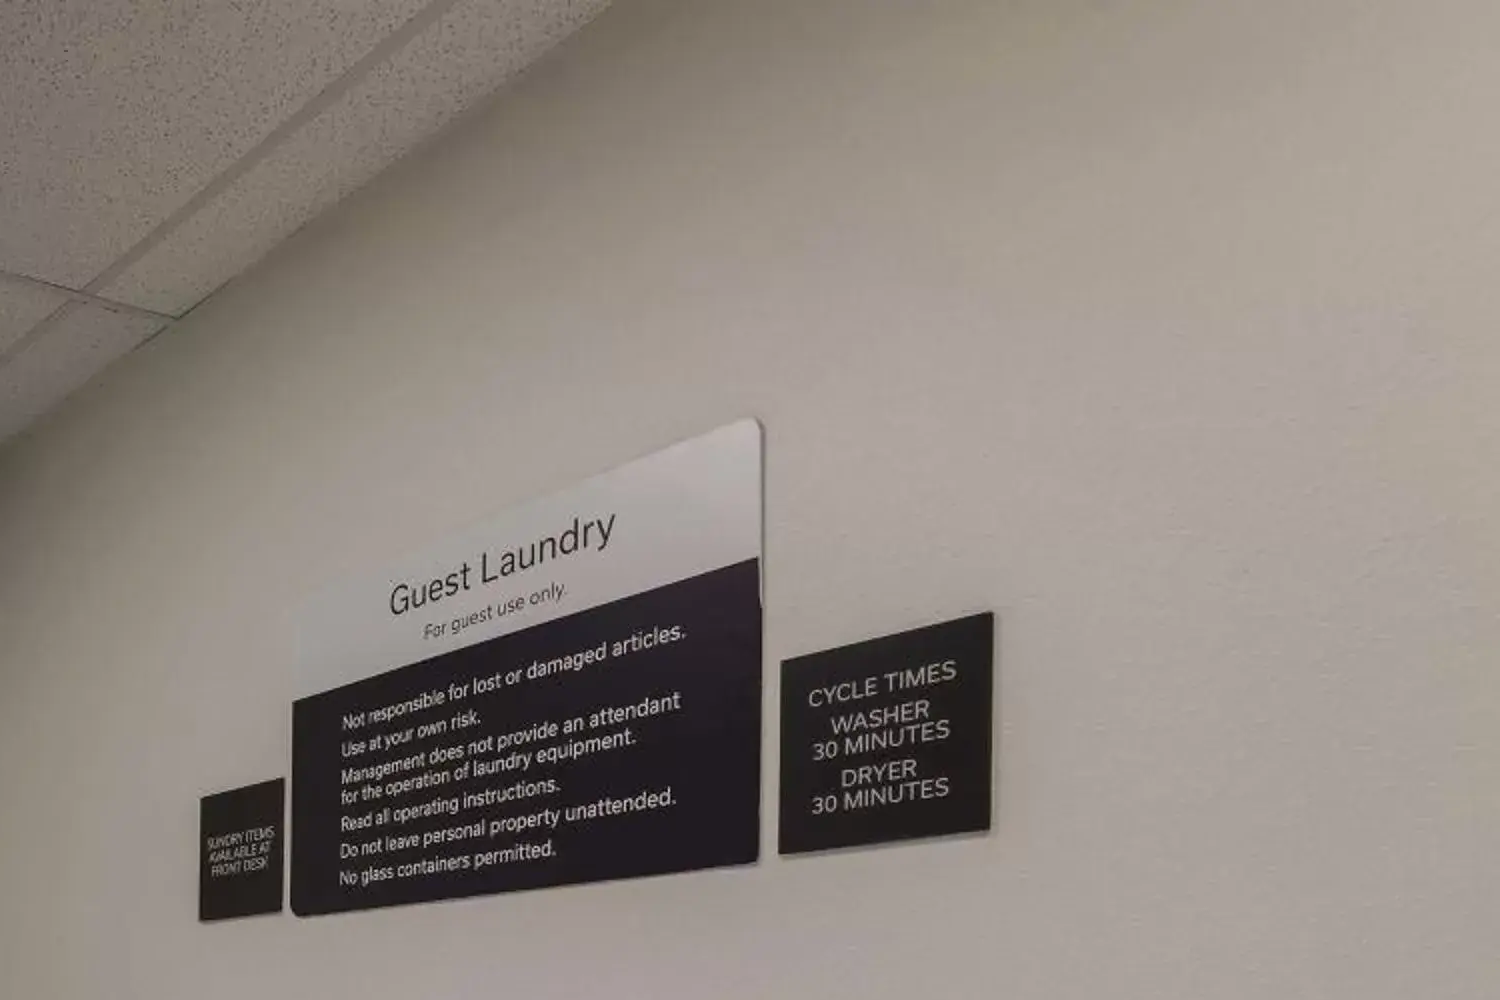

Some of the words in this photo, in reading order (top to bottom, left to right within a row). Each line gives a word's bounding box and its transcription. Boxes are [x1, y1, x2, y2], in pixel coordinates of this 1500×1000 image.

[390, 562, 472, 616] Guest
[481, 513, 616, 585] Laundry
[424, 622, 447, 640] For
[451, 605, 494, 635] guest
[497, 597, 526, 617] use
[529, 581, 568, 606] only.
[342, 711, 365, 731] Not
[368, 689, 445, 724] responsible
[448, 683, 469, 701] for
[472, 673, 501, 695] lost
[505, 669, 522, 685] or
[526, 641, 607, 679] damaged
[611, 625, 687, 657] articles.
[808, 677, 878, 707] CYCLE
[884, 660, 957, 693] TIMES
[341, 741, 366, 757] Use
[369, 735, 381, 751] at
[384, 727, 414, 750] your
[417, 720, 447, 738] own
[451, 708, 481, 730] risk.
[341, 752, 425, 785] Management
[429, 744, 464, 764] does
[468, 735, 493, 754] not
[497, 721, 558, 752] provide
[563, 717, 584, 734] an
[589, 691, 681, 728] attendant
[812, 741, 838, 761] 30
[845, 719, 951, 756] MINUTES
[831, 699, 930, 735] WASHER
[341, 789, 359, 805] for
[361, 784, 383, 801] the
[386, 770, 450, 796] operation
[454, 762, 469, 781] of
[473, 752, 532, 777] laundry
[536, 728, 637, 764] equipment.
[841, 759, 918, 788] DRYER
[341, 812, 372, 832] Read
[375, 808, 391, 825] all
[393, 797, 459, 824] operating
[463, 779, 561, 809] instructions.
[812, 795, 837, 815] 30
[844, 777, 950, 811] MINUTES
[340, 843, 359, 859] Do
[361, 838, 382, 855] not
[385, 833, 420, 851] leave
[423, 819, 485, 848] personal
[489, 809, 560, 839] property
[565, 786, 677, 821] unattended.
[211, 861, 242, 877] FRONT
[243, 856, 269, 872] DESK
[339, 870, 359, 886] No
[361, 866, 394, 887] glass
[397, 855, 470, 877] containers
[474, 839, 556, 870] permitted.
